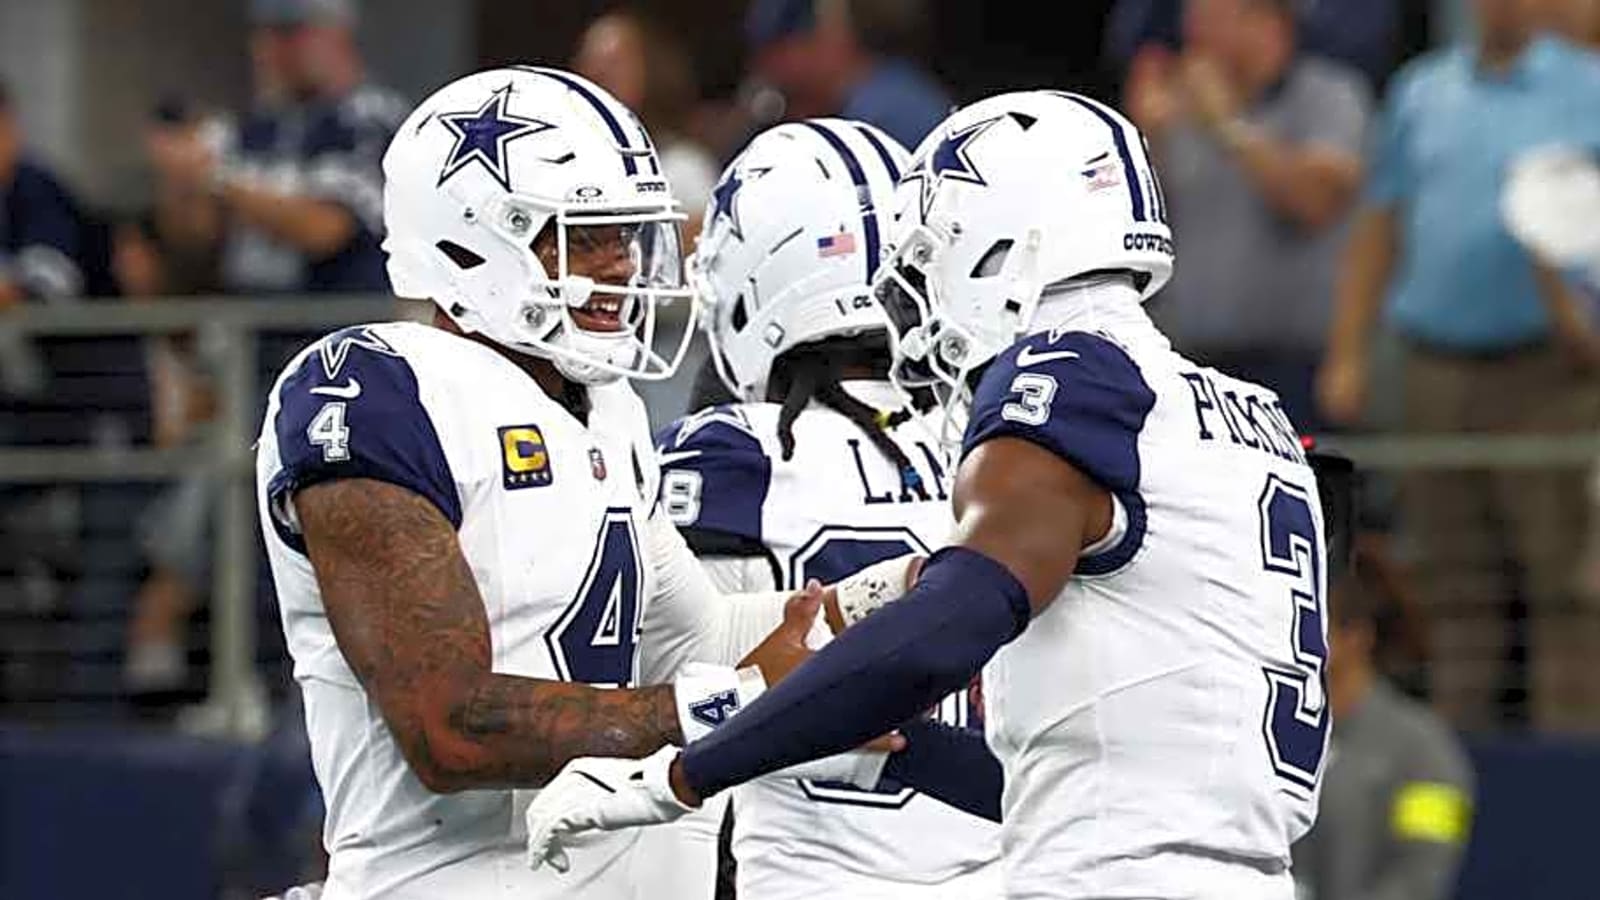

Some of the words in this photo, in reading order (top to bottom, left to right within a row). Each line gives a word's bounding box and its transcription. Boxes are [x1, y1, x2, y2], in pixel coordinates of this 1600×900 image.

[1001, 372, 1059, 426] 3
[306, 401, 350, 462] 4
[504, 428, 547, 473] C
[662, 468, 703, 527] 8
[543, 507, 644, 688] 4
[1259, 473, 1332, 792] 3
[688, 688, 741, 731] 4
